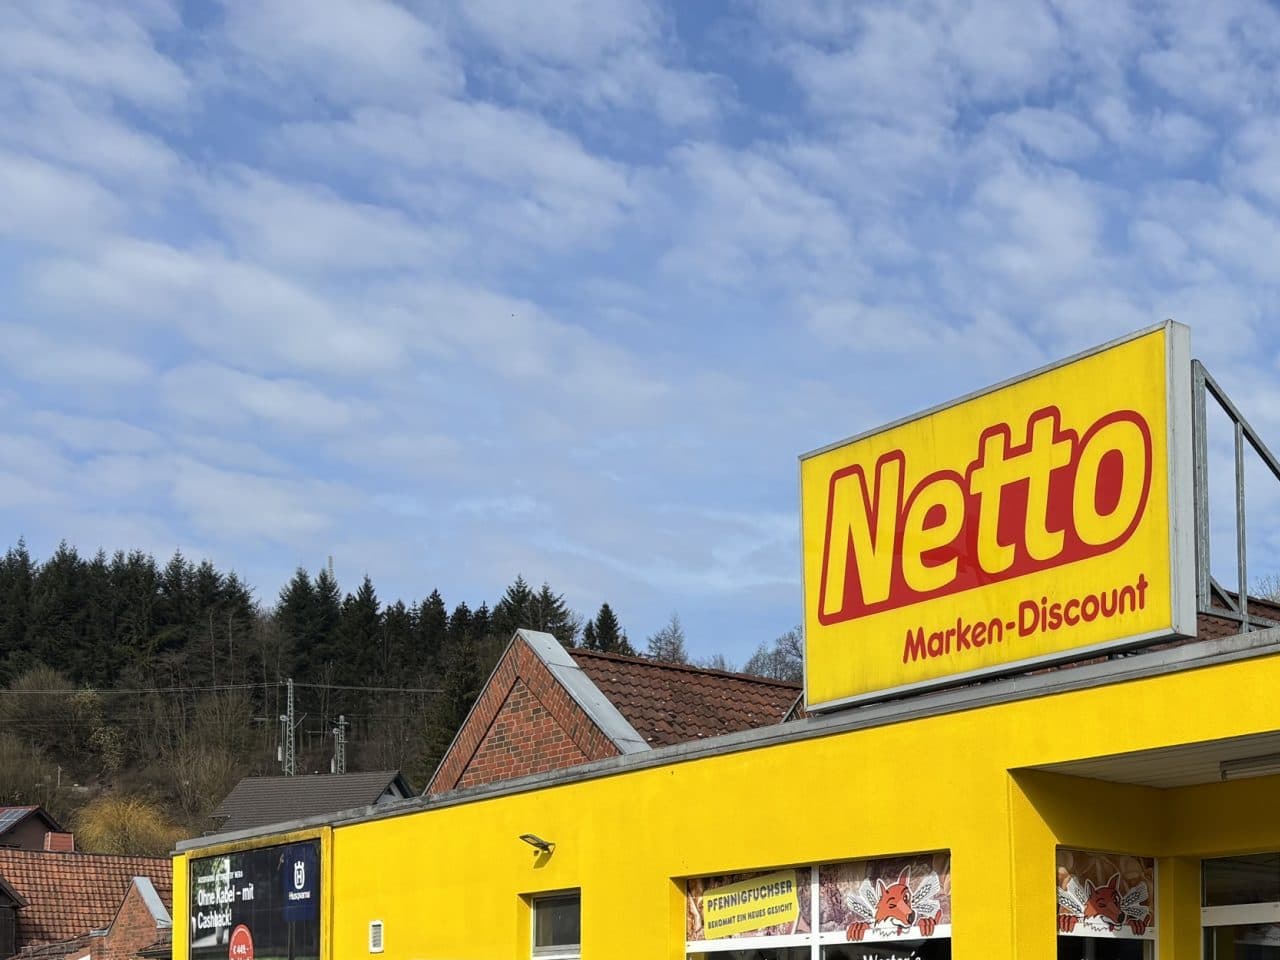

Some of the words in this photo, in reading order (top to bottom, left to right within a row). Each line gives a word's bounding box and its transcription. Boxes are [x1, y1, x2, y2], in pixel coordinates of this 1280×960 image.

[818, 405, 1152, 626] Netto
[903, 573, 1148, 663] Marken-Discount
[197, 888, 215, 906] Ohne
[216, 884, 235, 904] Kabel
[242, 882, 254, 901] mit
[707, 880, 793, 912] PFENNIGFUCHSER
[197, 908, 232, 929] Cashback!
[708, 915, 735, 929] BEKOMMT
[737, 913, 747, 922] EIN
[747, 908, 766, 920] NEUES
[766, 902, 793, 915] GESICHT
